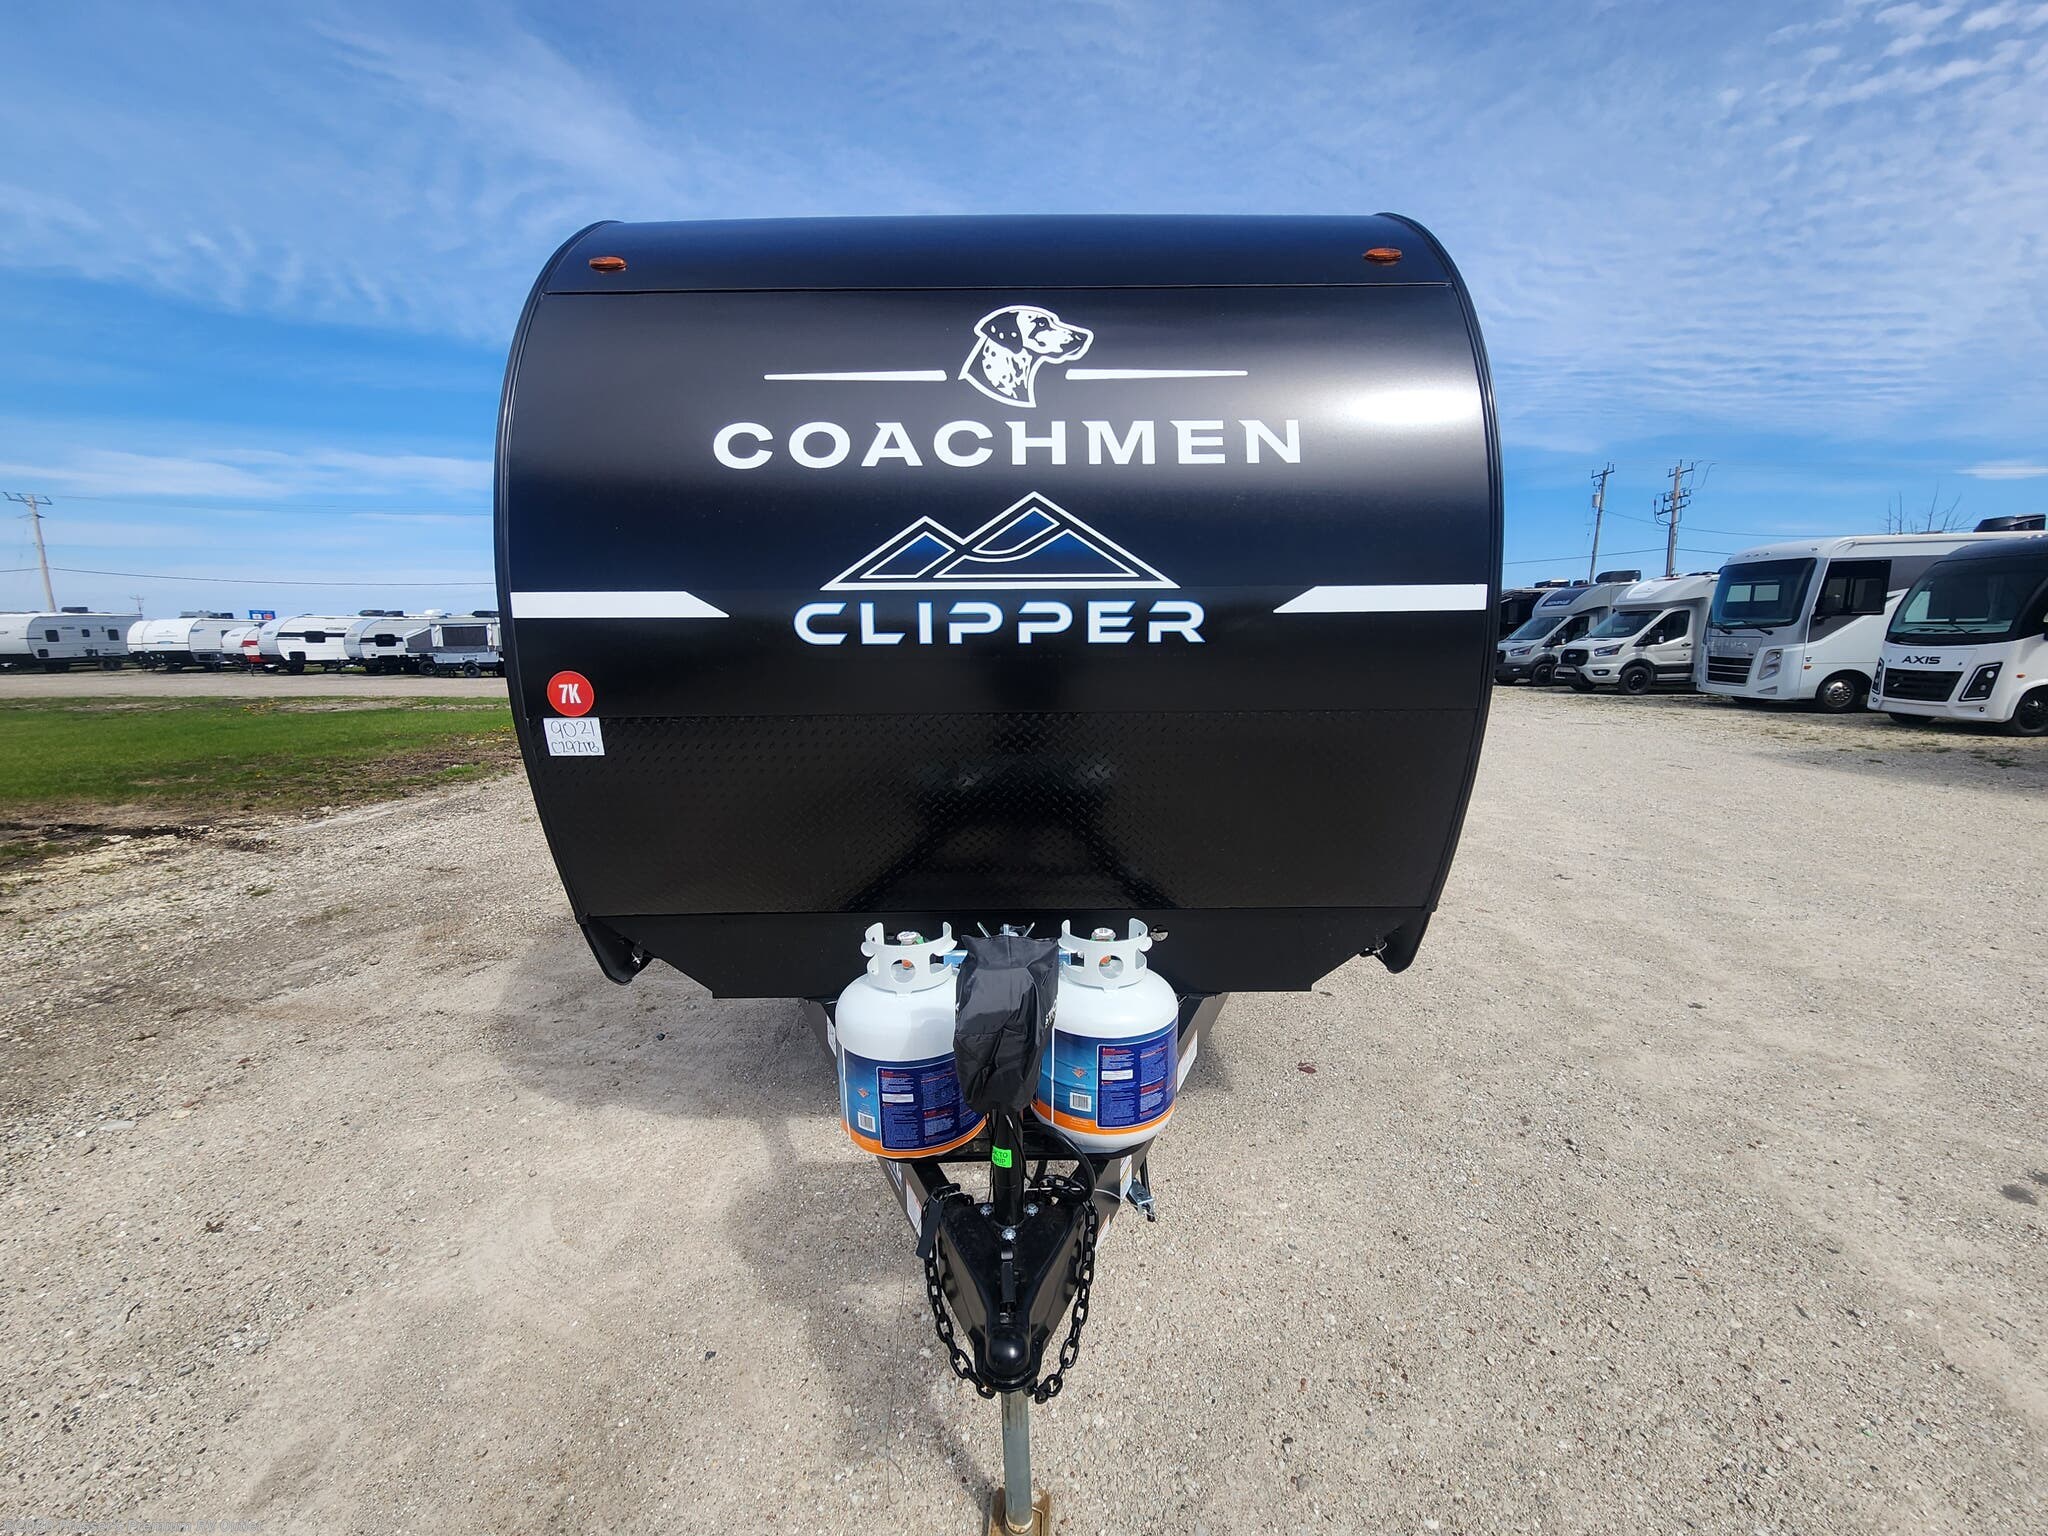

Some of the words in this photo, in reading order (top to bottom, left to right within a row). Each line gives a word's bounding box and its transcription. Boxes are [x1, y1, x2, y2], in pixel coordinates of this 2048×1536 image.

[712, 419, 1302, 469] COACHMEN
[794, 601, 1206, 646] CLIPPER
[1902, 655, 1942, 665] AXIS
[558, 683, 582, 704] 7K
[550, 720, 596, 739] 9021
